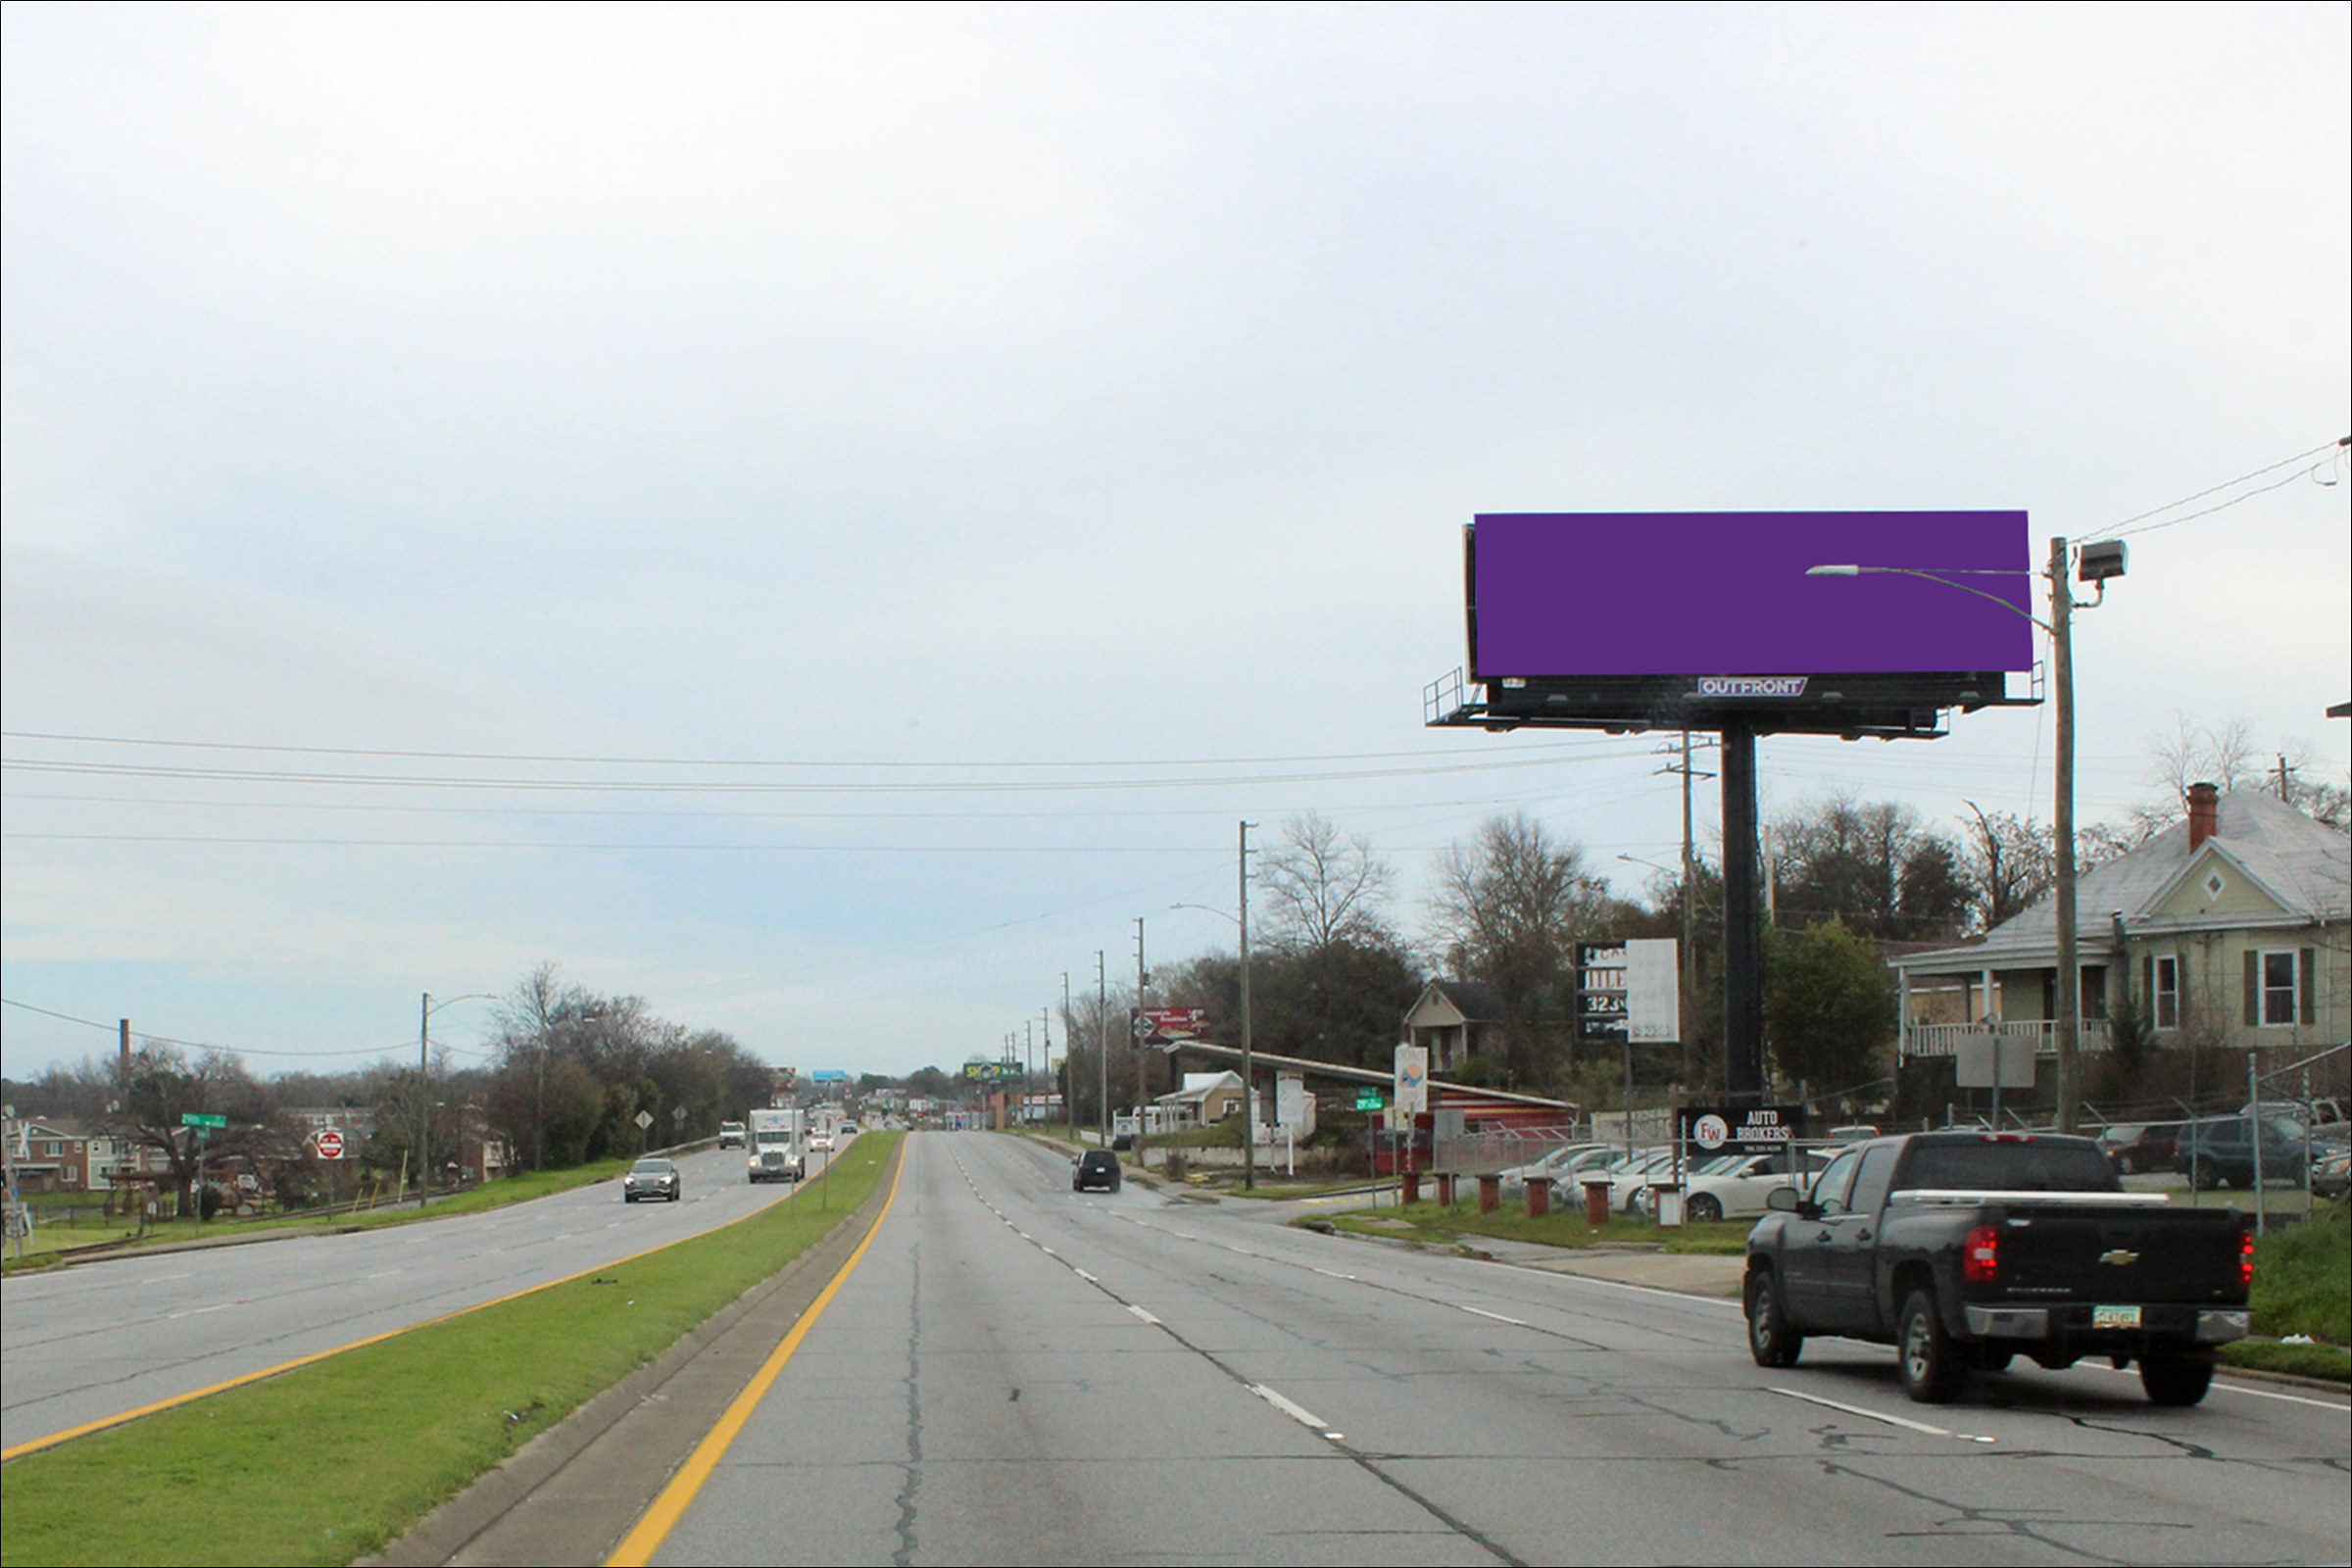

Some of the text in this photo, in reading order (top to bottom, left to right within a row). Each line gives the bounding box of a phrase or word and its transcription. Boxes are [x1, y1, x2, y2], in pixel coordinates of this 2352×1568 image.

[1702, 679, 1802, 694] OUTFRONT
[1746, 1110, 1779, 1126] AUTO
[1737, 1126, 1789, 1141] BROKERS
